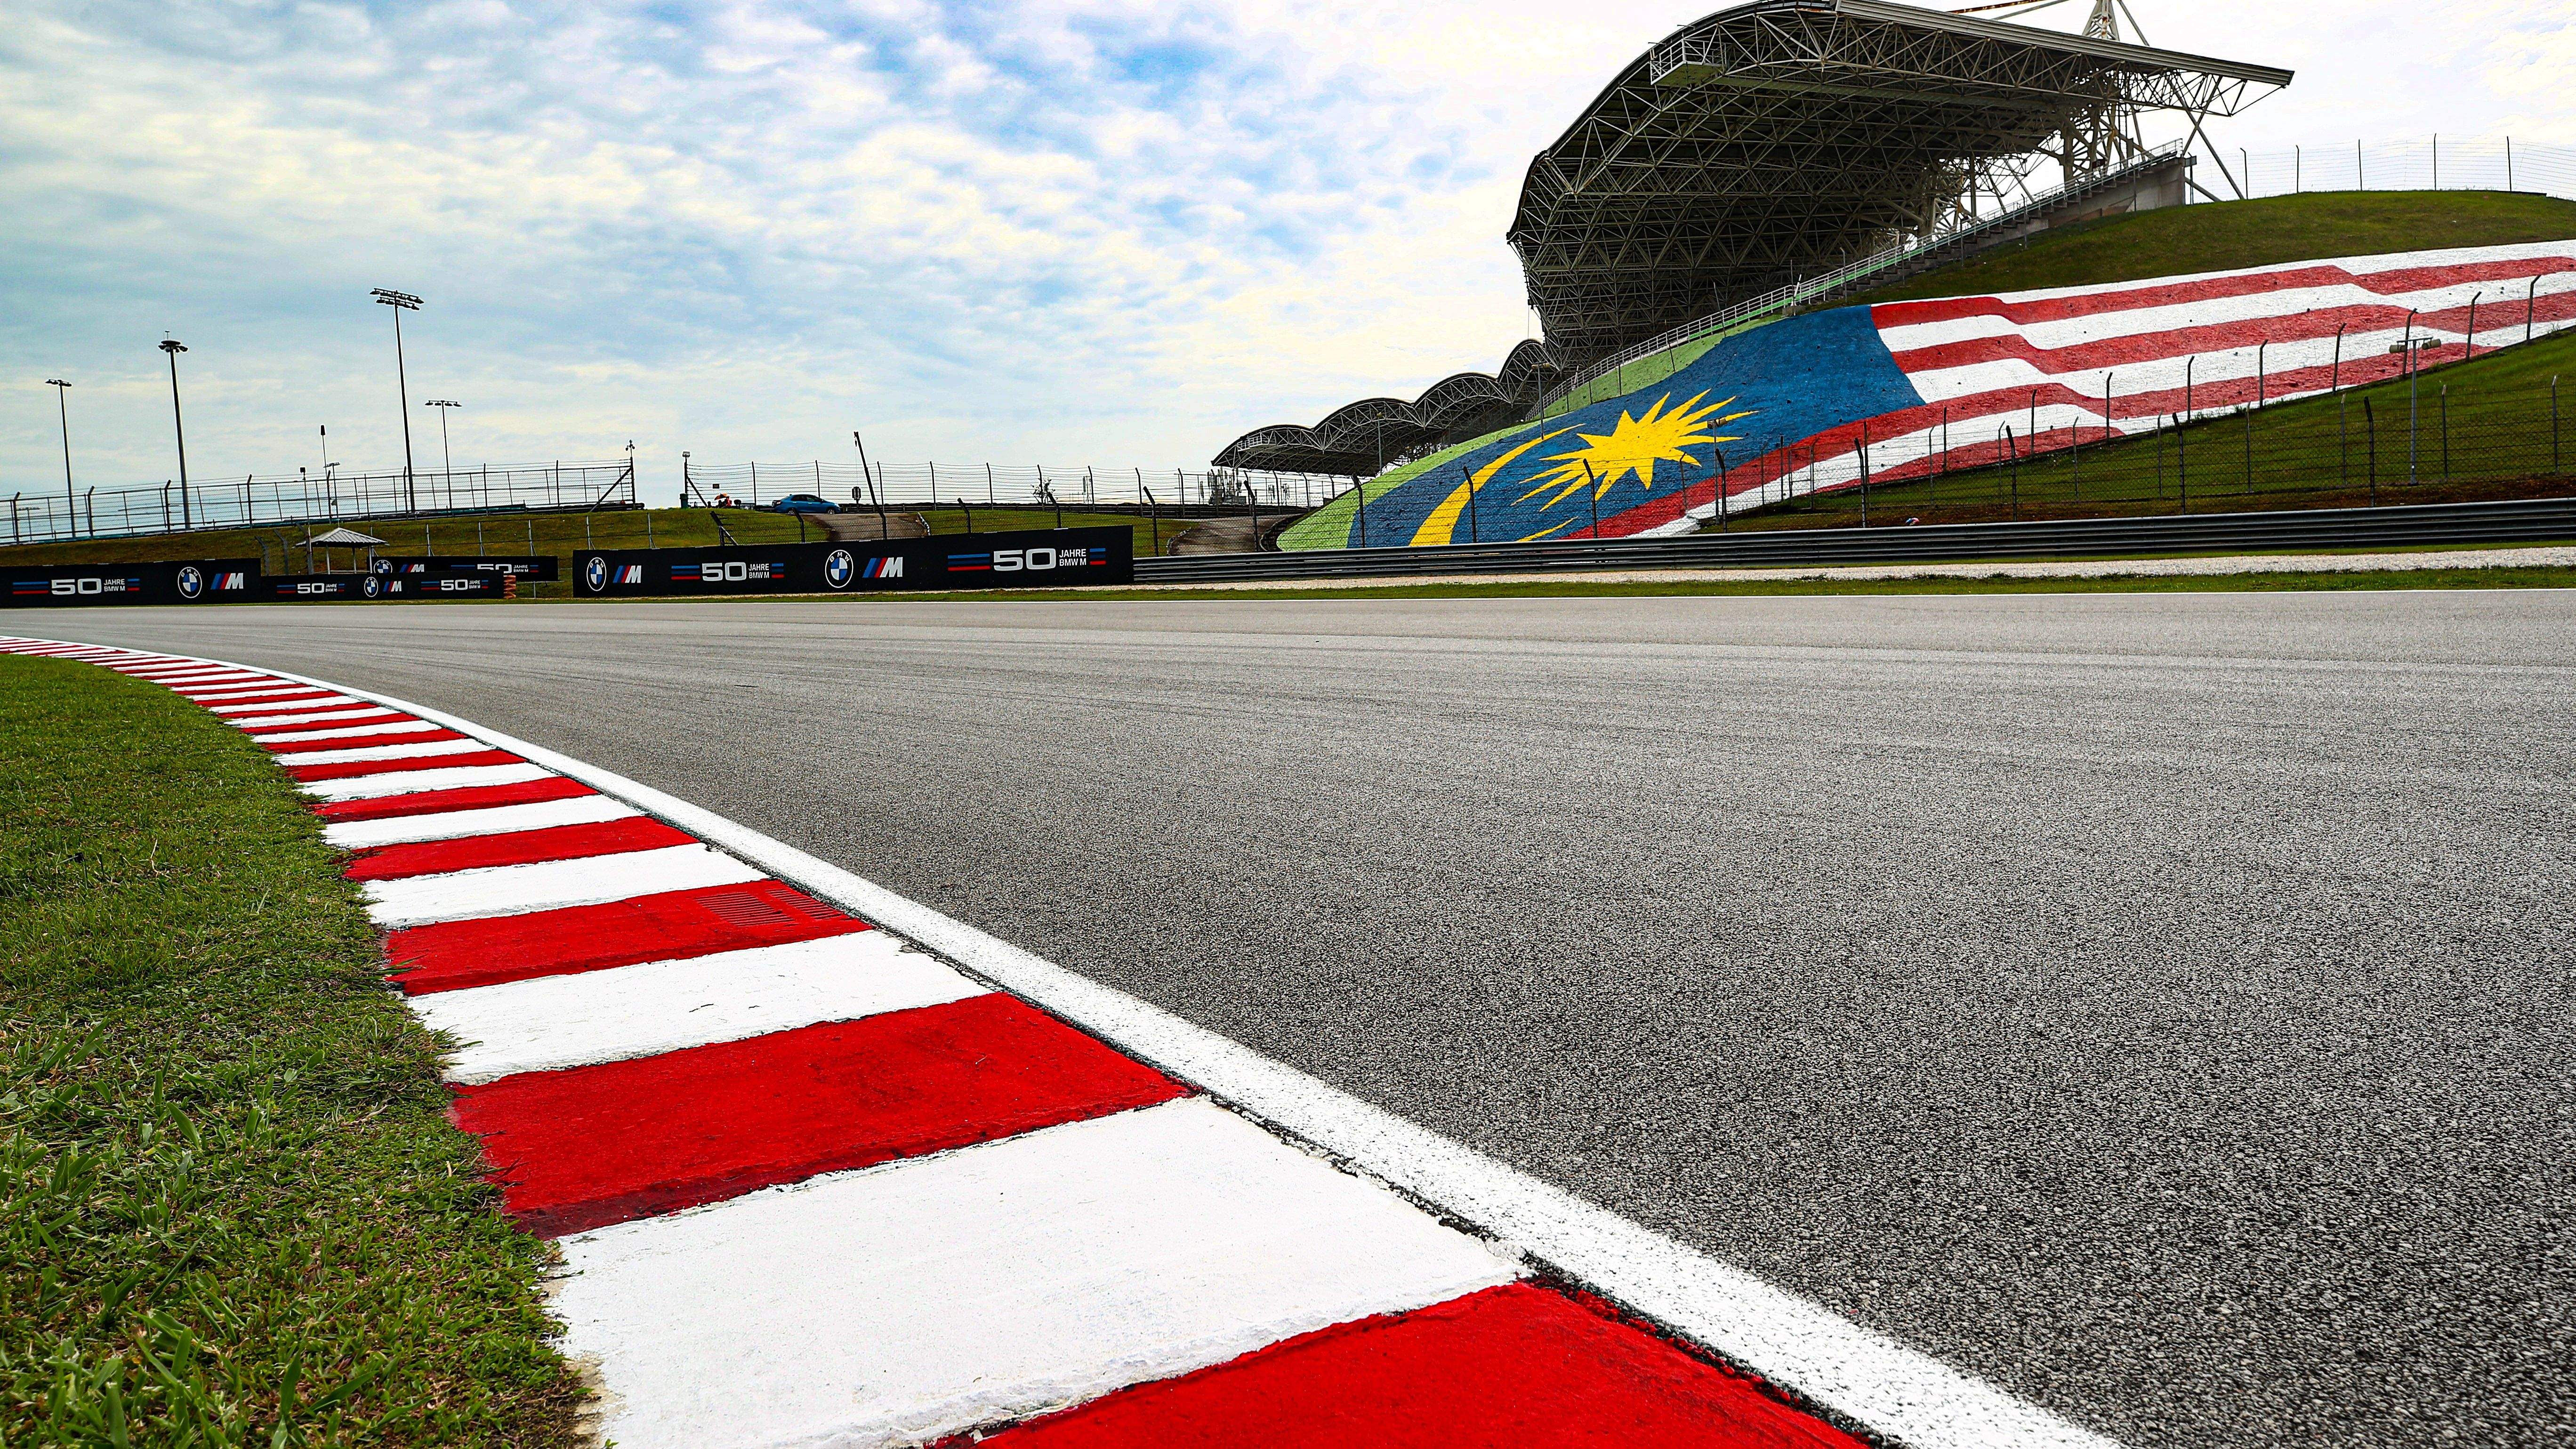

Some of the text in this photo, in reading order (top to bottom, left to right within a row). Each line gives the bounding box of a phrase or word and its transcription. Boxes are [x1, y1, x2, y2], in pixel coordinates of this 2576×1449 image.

[829, 552, 850, 563] BMW
[993, 548, 1087, 571] 50 JAHRE
[1059, 558, 1087, 566] BMW M
[477, 564, 512, 573] 50
[625, 565, 642, 583] M
[702, 562, 747, 581] 50
[879, 556, 903, 578] M
[51, 578, 102, 595] 50
[225, 572, 244, 589] M
[391, 580, 402, 592] M
[441, 579, 468, 590] 50
[298, 583, 325, 594] 50
